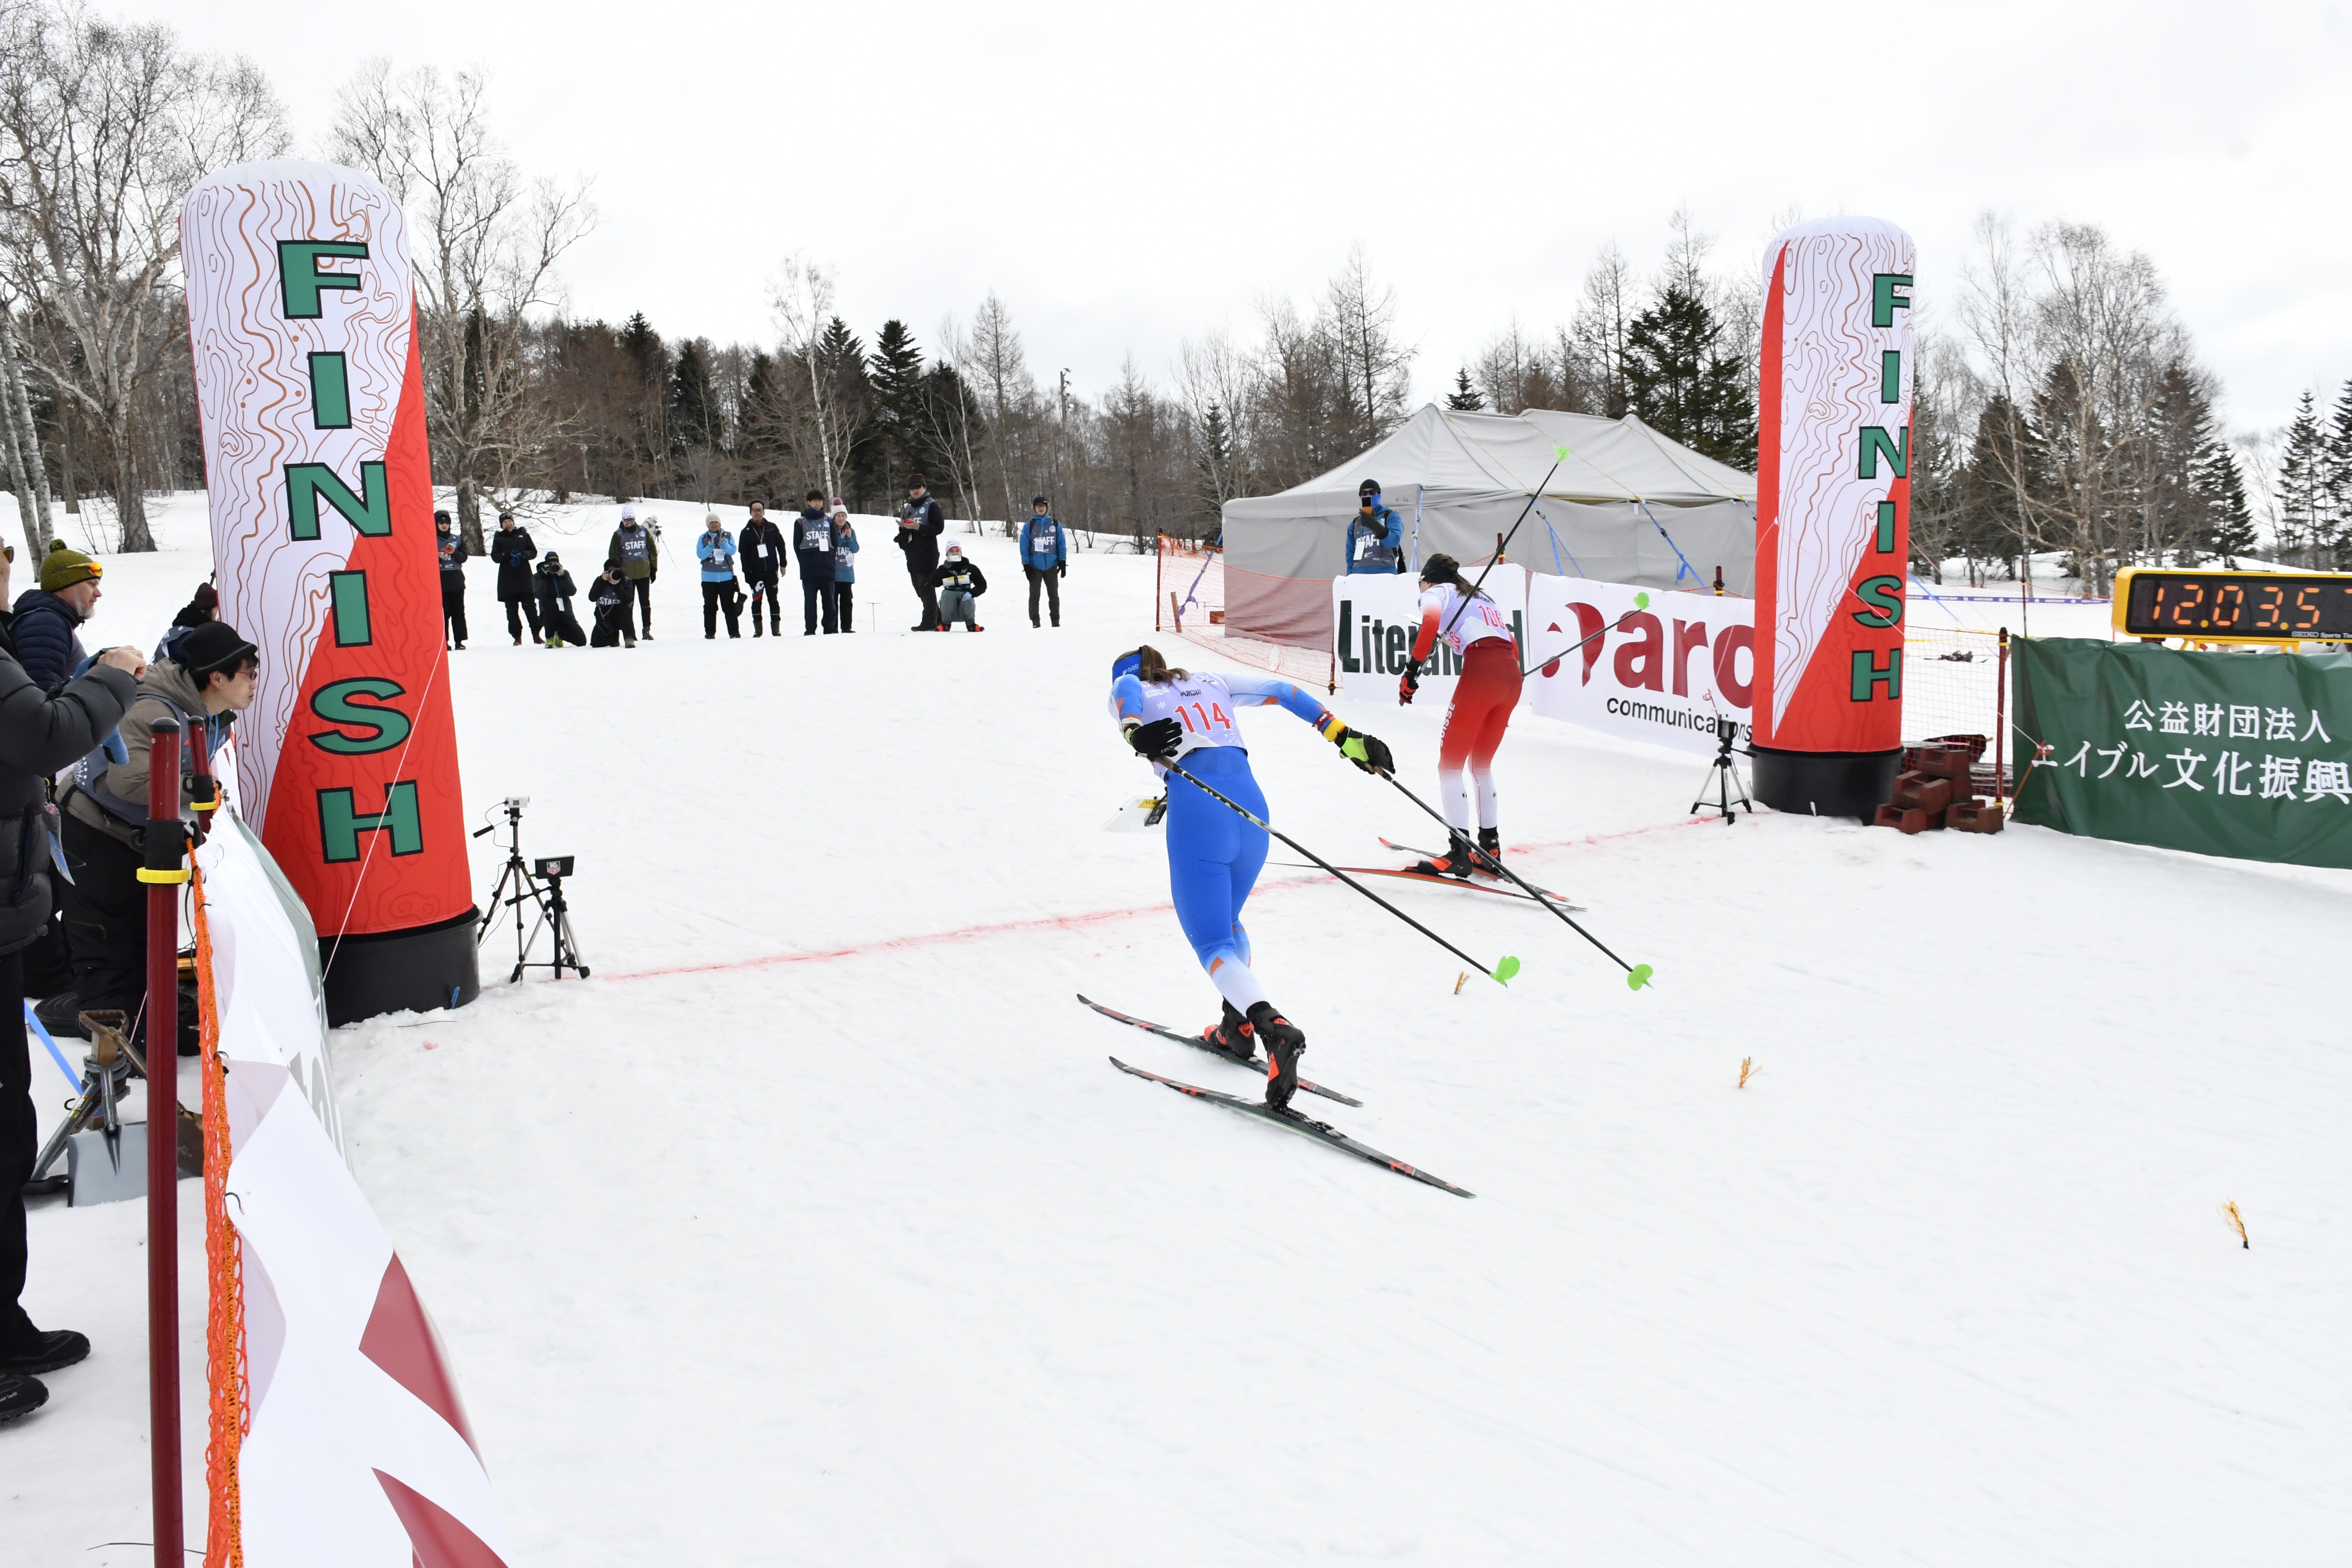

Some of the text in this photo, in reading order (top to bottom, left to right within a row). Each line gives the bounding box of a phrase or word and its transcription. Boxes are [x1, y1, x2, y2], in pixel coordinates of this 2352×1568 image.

[1850, 273, 1913, 702] FINISH
[276, 240, 424, 864] FINISH
[625, 540, 645, 550] STAFF
[806, 531, 828, 540] STAFF
[836, 546, 853, 555] TAF
[1033, 536, 1055, 545] AFF
[599, 596, 621, 606] STAFF
[2153, 585, 2352, 629] 12.03.5
[1174, 702, 1231, 733] 114
[1606, 697, 1753, 742] communicaons
[2123, 698, 2332, 743] 公益財団法人
[2031, 740, 2352, 805] エイブル文化振興
